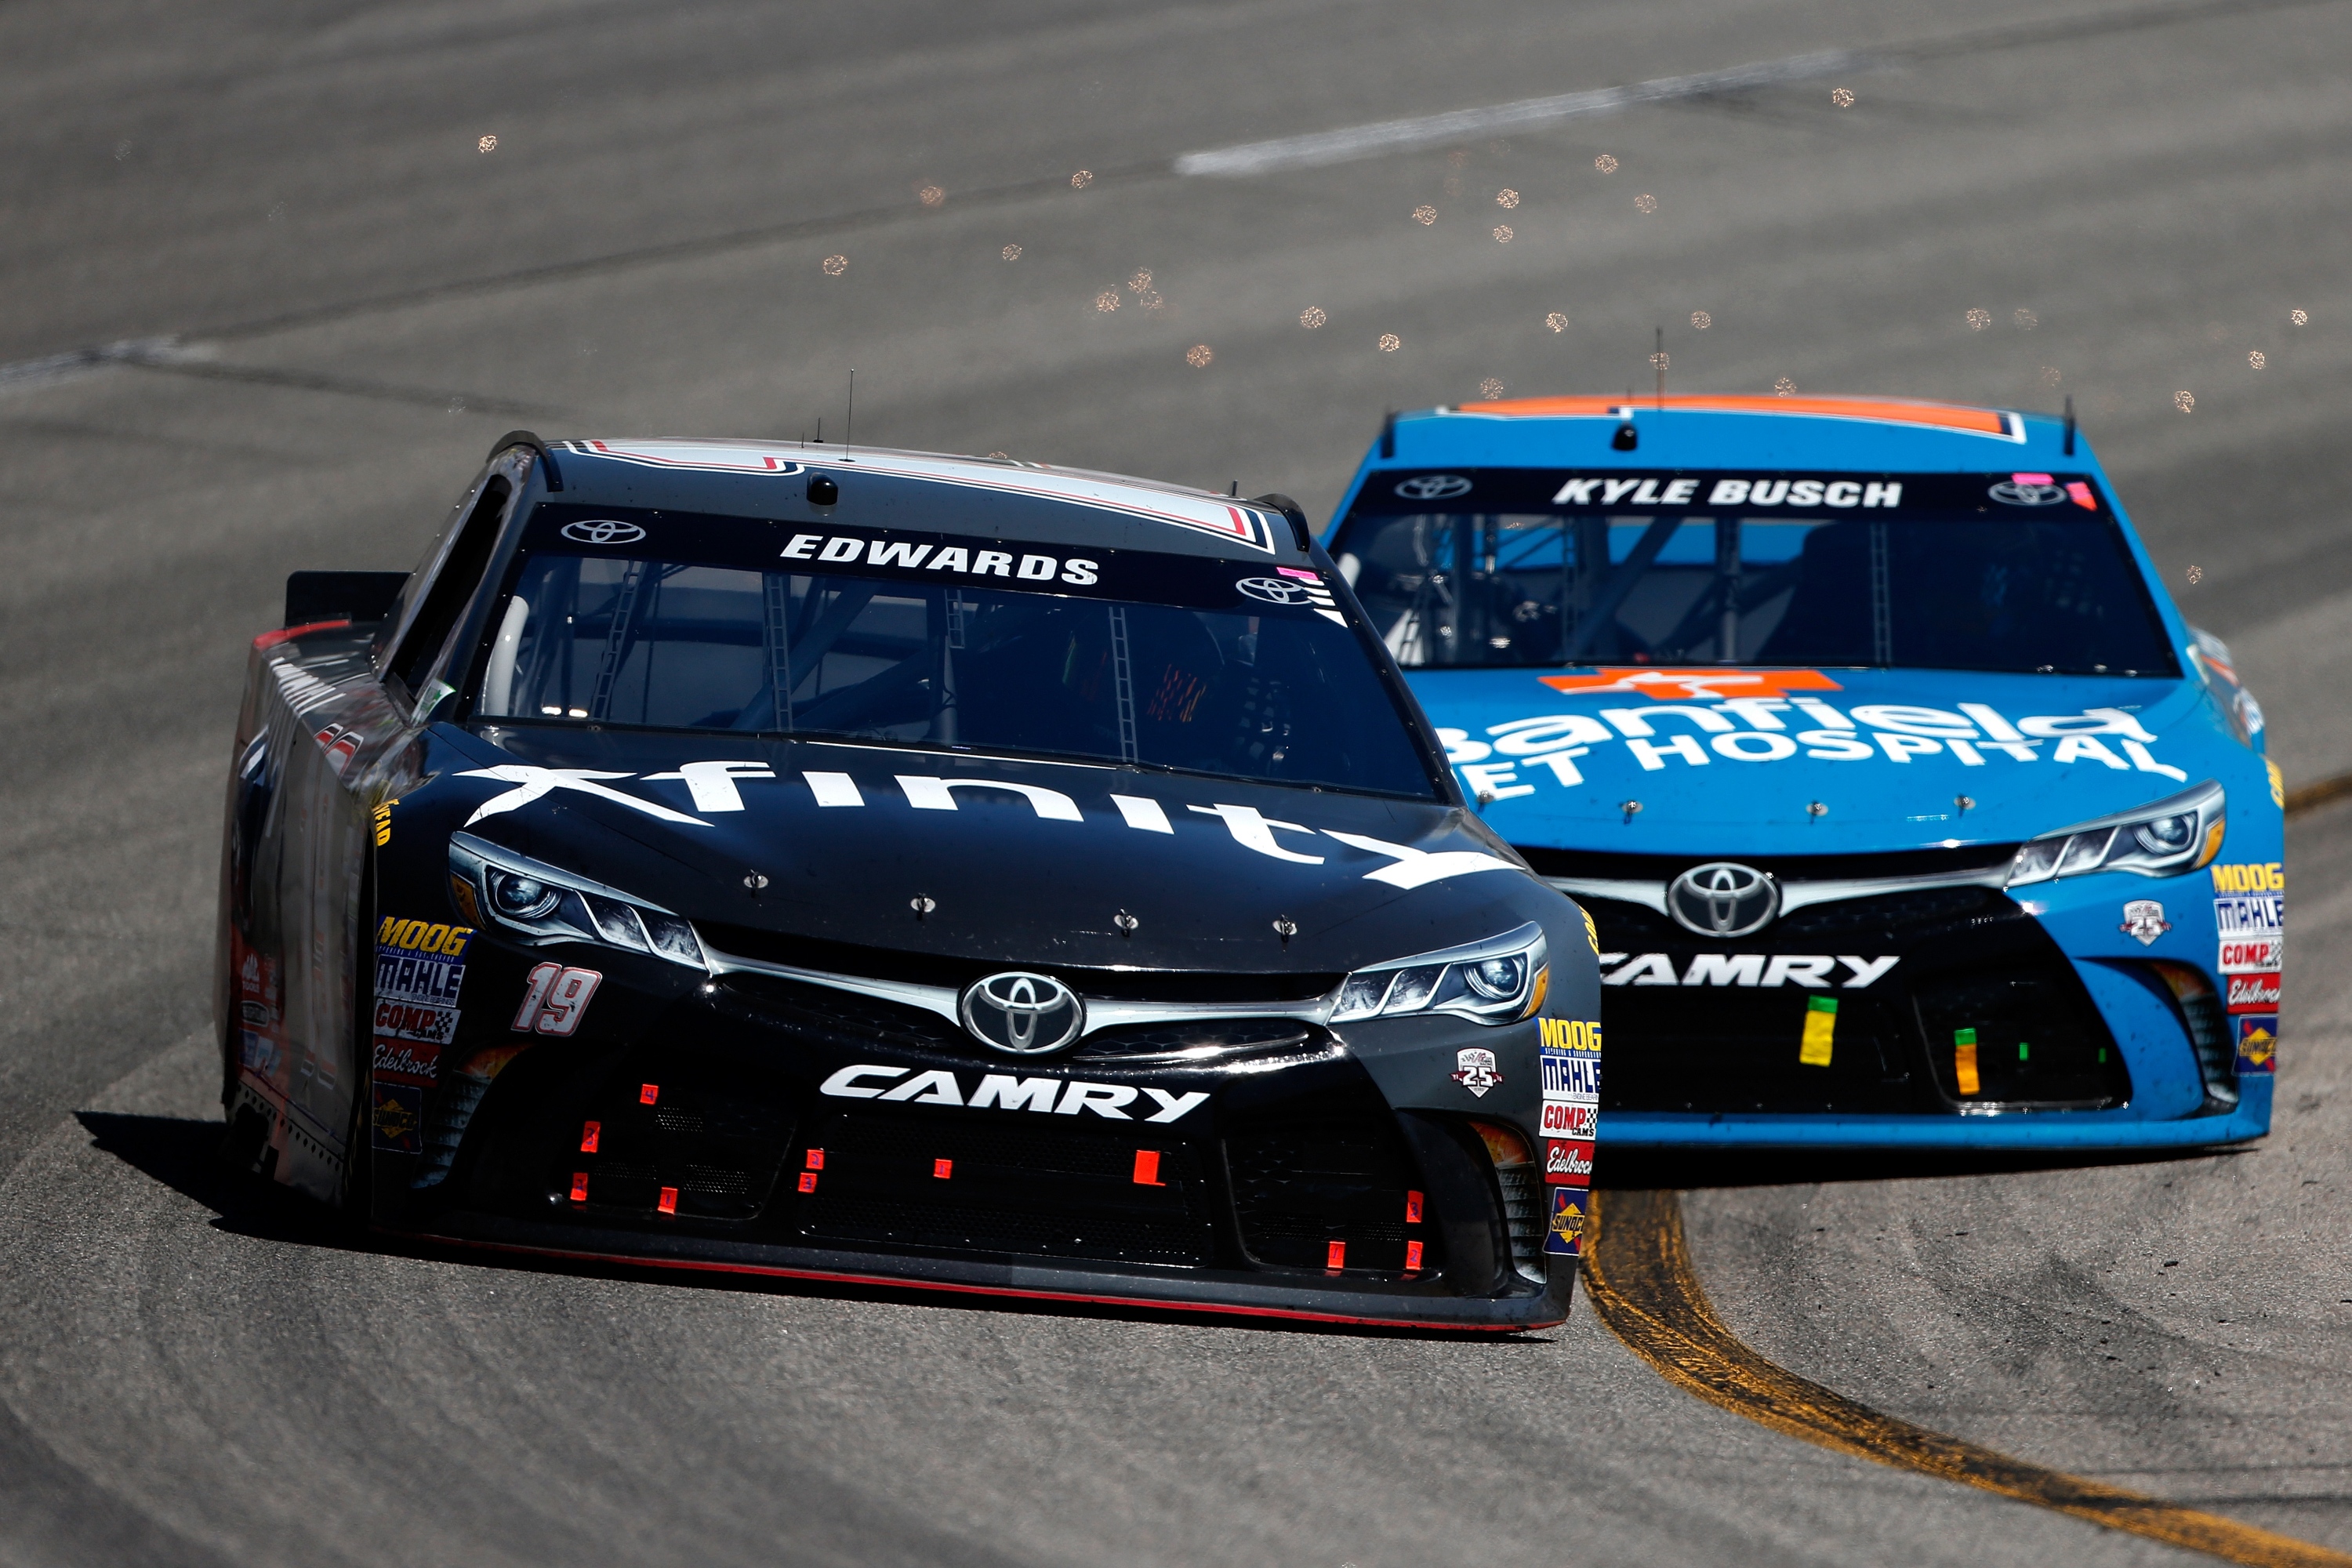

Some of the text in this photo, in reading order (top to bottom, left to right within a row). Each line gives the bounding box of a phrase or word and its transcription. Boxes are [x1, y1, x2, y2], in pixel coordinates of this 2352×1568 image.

[1552, 478, 1903, 509] KYLE BUSCH
[779, 533, 1099, 587] EDWARDS
[1627, 731, 2189, 782] HOSPITAL
[2210, 862, 2285, 892] MOOG
[376, 916, 474, 956] MOOG
[2223, 942, 2269, 964] COMP
[377, 956, 464, 998] MAHLE
[510, 961, 604, 1037] 19
[375, 1003, 437, 1031] COMP
[1537, 1017, 1602, 1052] MOOG
[1463, 1066, 1494, 1087] 25
[644, 1089, 655, 1102] 4
[818, 1063, 1211, 1124] CAMRY
[1544, 1104, 1587, 1131] COMP
[1571, 1127, 1595, 1137] CAMS
[1410, 1201, 1419, 1218] 3
[1410, 1249, 1418, 1263] 2
